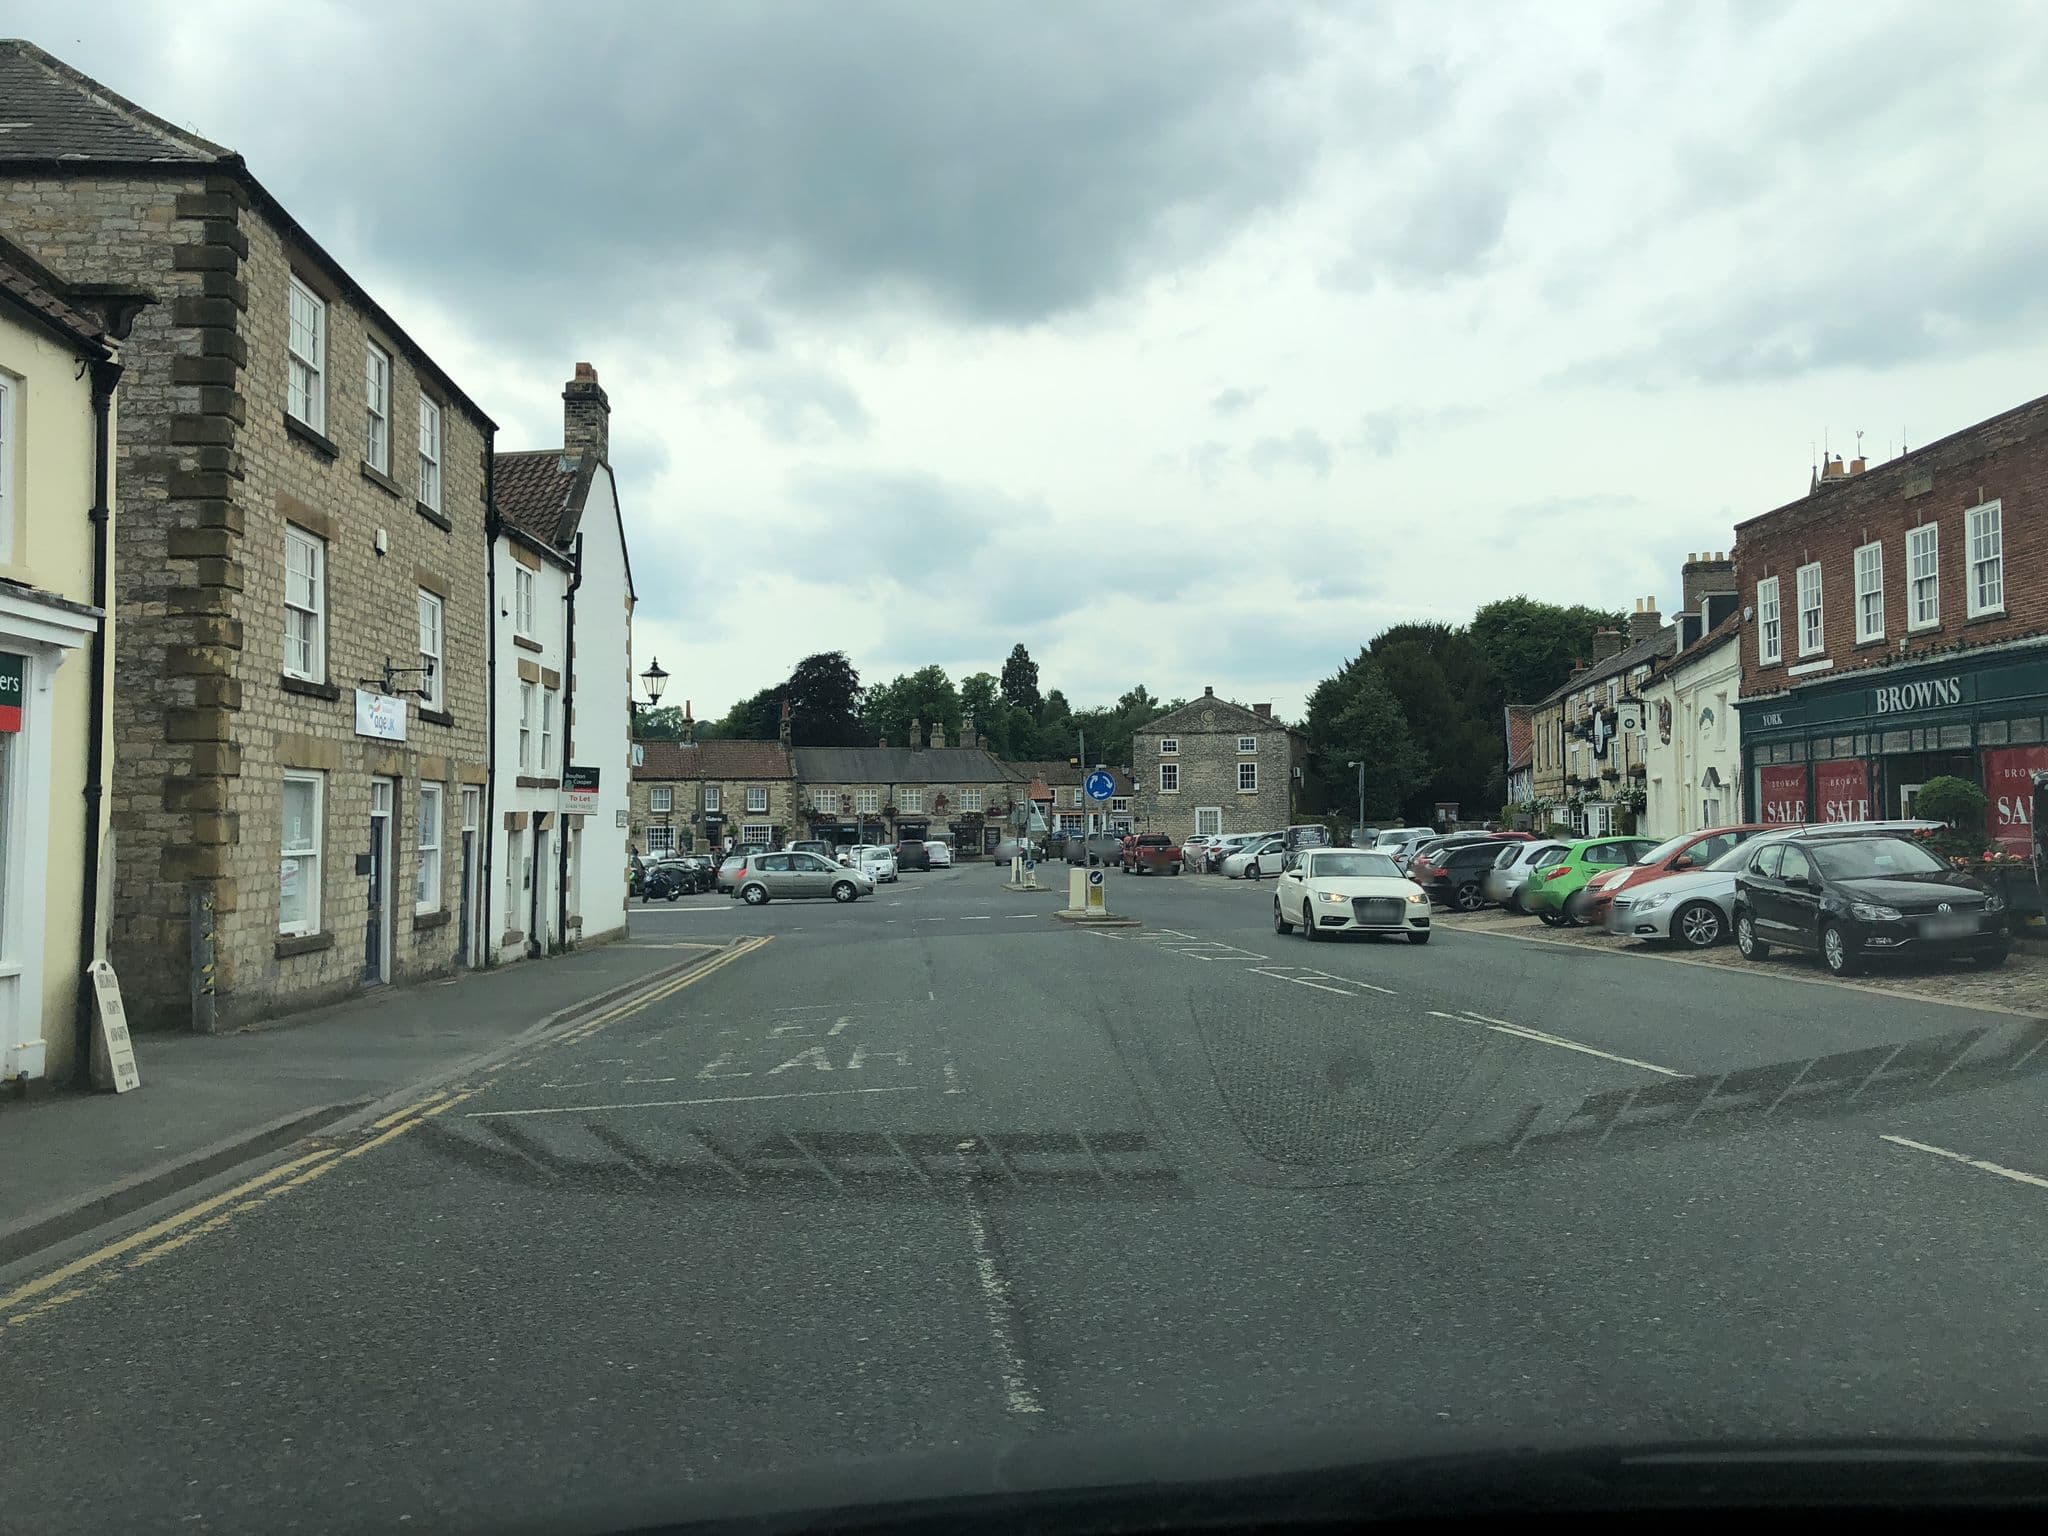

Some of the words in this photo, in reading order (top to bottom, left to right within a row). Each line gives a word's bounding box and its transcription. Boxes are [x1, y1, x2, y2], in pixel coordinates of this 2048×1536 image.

[1875, 676, 1961, 714] BROWNS
[1762, 712, 1783, 727] YORK
[1767, 800, 1807, 823] SALE
[1826, 799, 1870, 823] SALE
